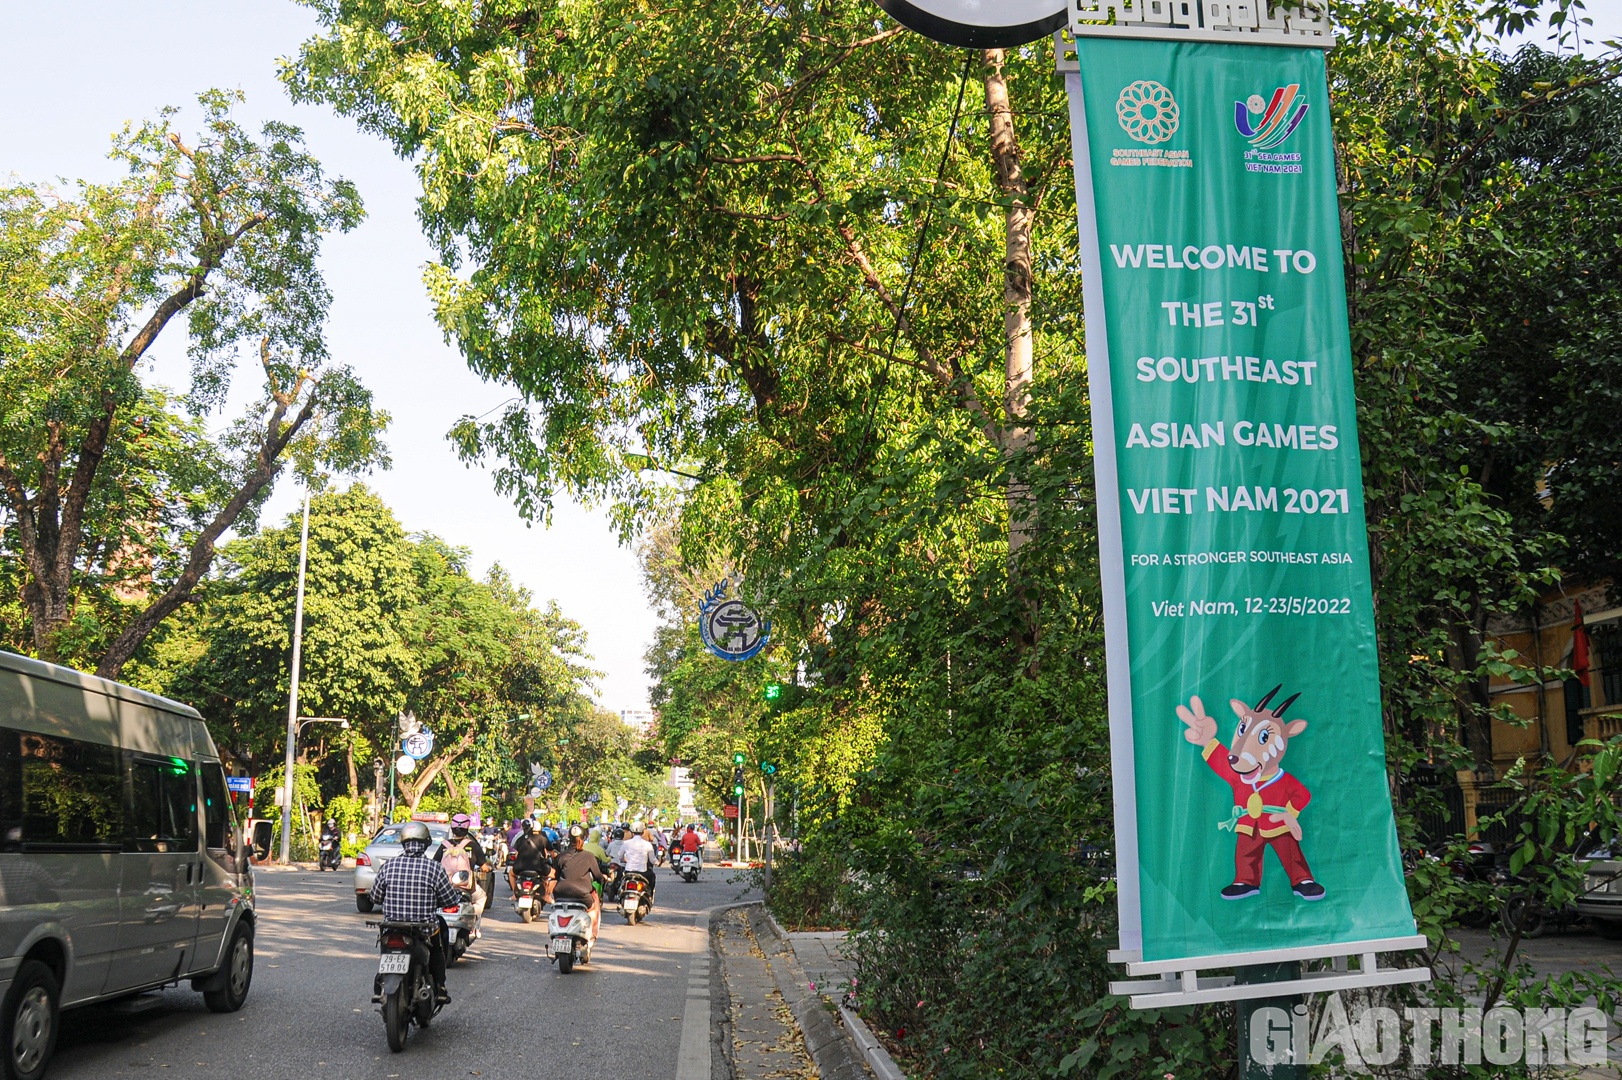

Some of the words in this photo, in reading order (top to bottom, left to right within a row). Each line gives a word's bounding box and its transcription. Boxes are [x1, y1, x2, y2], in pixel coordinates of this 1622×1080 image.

[1110, 157, 1141, 166] GAMES
[1142, 157, 1193, 167] FEDERATION
[1112, 149, 1163, 157] SOUTHEAST
[1164, 150, 1189, 158] ASIAN
[1258, 152, 1273, 161] SEA
[1273, 153, 1301, 161] GAMES
[1245, 162, 1262, 172] VIET
[1263, 164, 1282, 173] NAM
[1283, 164, 1302, 173] 2021
[1110, 244, 1268, 272] WELCOME
[1273, 249, 1317, 274] TO
[1161, 301, 1224, 327] THE
[1136, 355, 1317, 386] SOUTHEAST
[1125, 421, 1225, 448] ASIAN
[1232, 421, 1339, 450] GAMES
[1127, 488, 1198, 514] VIET
[1207, 486, 1278, 512] NAM
[1283, 488, 1349, 514] 2021
[1131, 553, 1159, 566] FOR
[1162, 554, 1173, 566] A
[1174, 551, 1247, 566] STRONGER
[1249, 550, 1319, 564] SOUTHEAST
[1321, 553, 1353, 564] ASIA
[1151, 600, 1185, 617] Viet
[1189, 600, 1239, 616] Nam,
[1244, 596, 1351, 616] 12-23/5/2022
